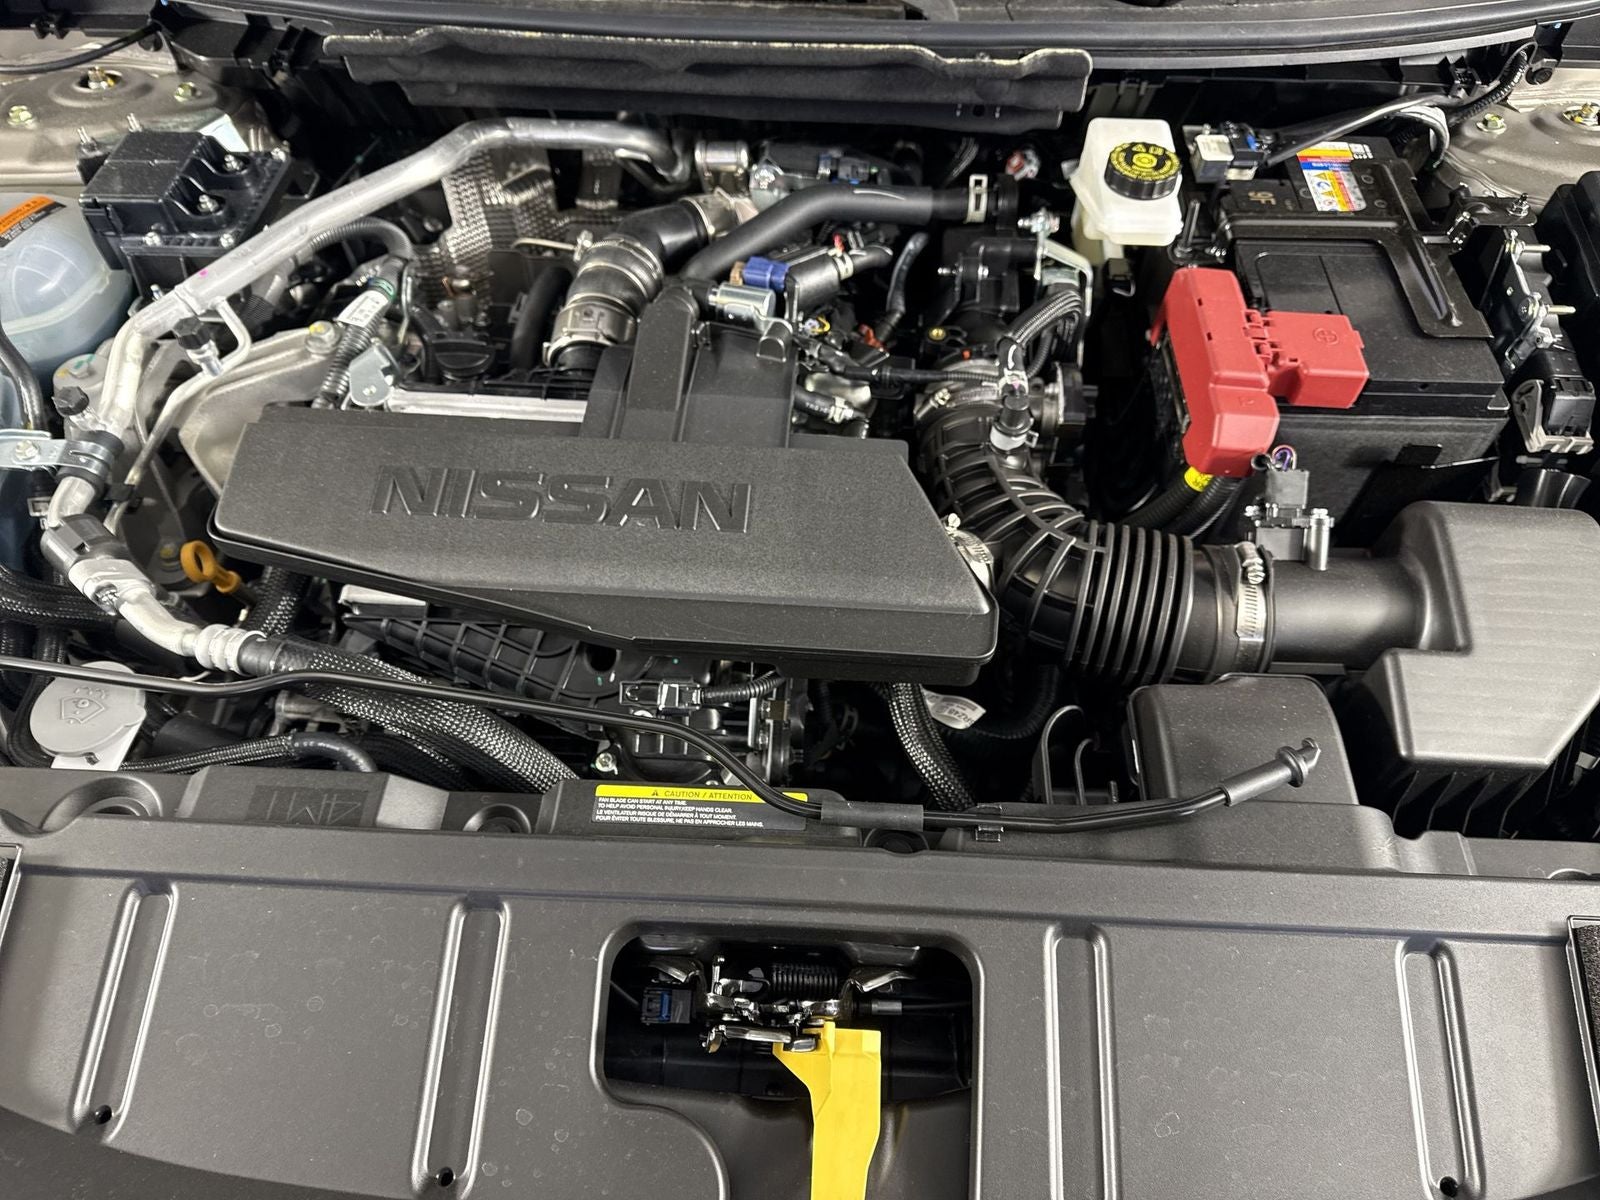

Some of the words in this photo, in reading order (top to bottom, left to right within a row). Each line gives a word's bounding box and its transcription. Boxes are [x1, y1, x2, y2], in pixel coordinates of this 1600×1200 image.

[370, 465, 752, 534] NISSAN
[664, 790, 700, 798] CAUTION
[708, 792, 753, 800] ATTENTION
[611, 814, 630, 822] ÉVITER
